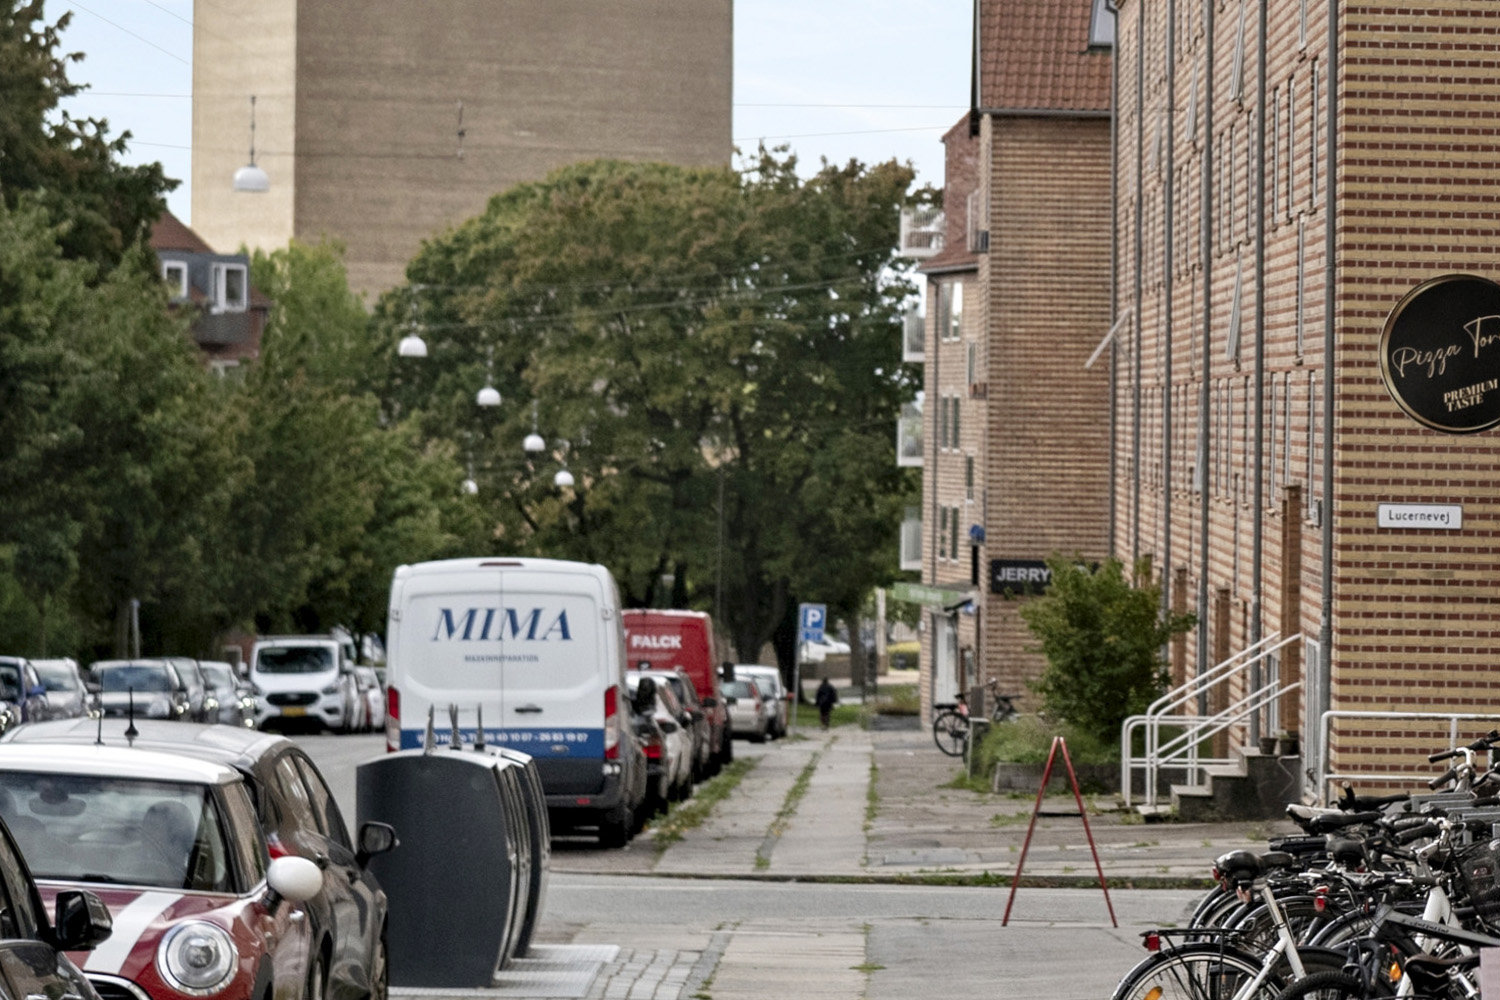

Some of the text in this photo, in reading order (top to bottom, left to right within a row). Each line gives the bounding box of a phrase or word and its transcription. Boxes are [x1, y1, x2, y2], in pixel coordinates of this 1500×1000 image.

[1392, 345, 1463, 379] Pizza
[1443, 378, 1499, 404] PREMIUM
[1446, 393, 1484, 413] TASTE
[1388, 509, 1450, 525] Lucernevej
[996, 567, 1051, 582] JERRY
[431, 606, 573, 642] MIMA
[807, 608, 822, 627] P
[631, 634, 683, 649] FALCK
